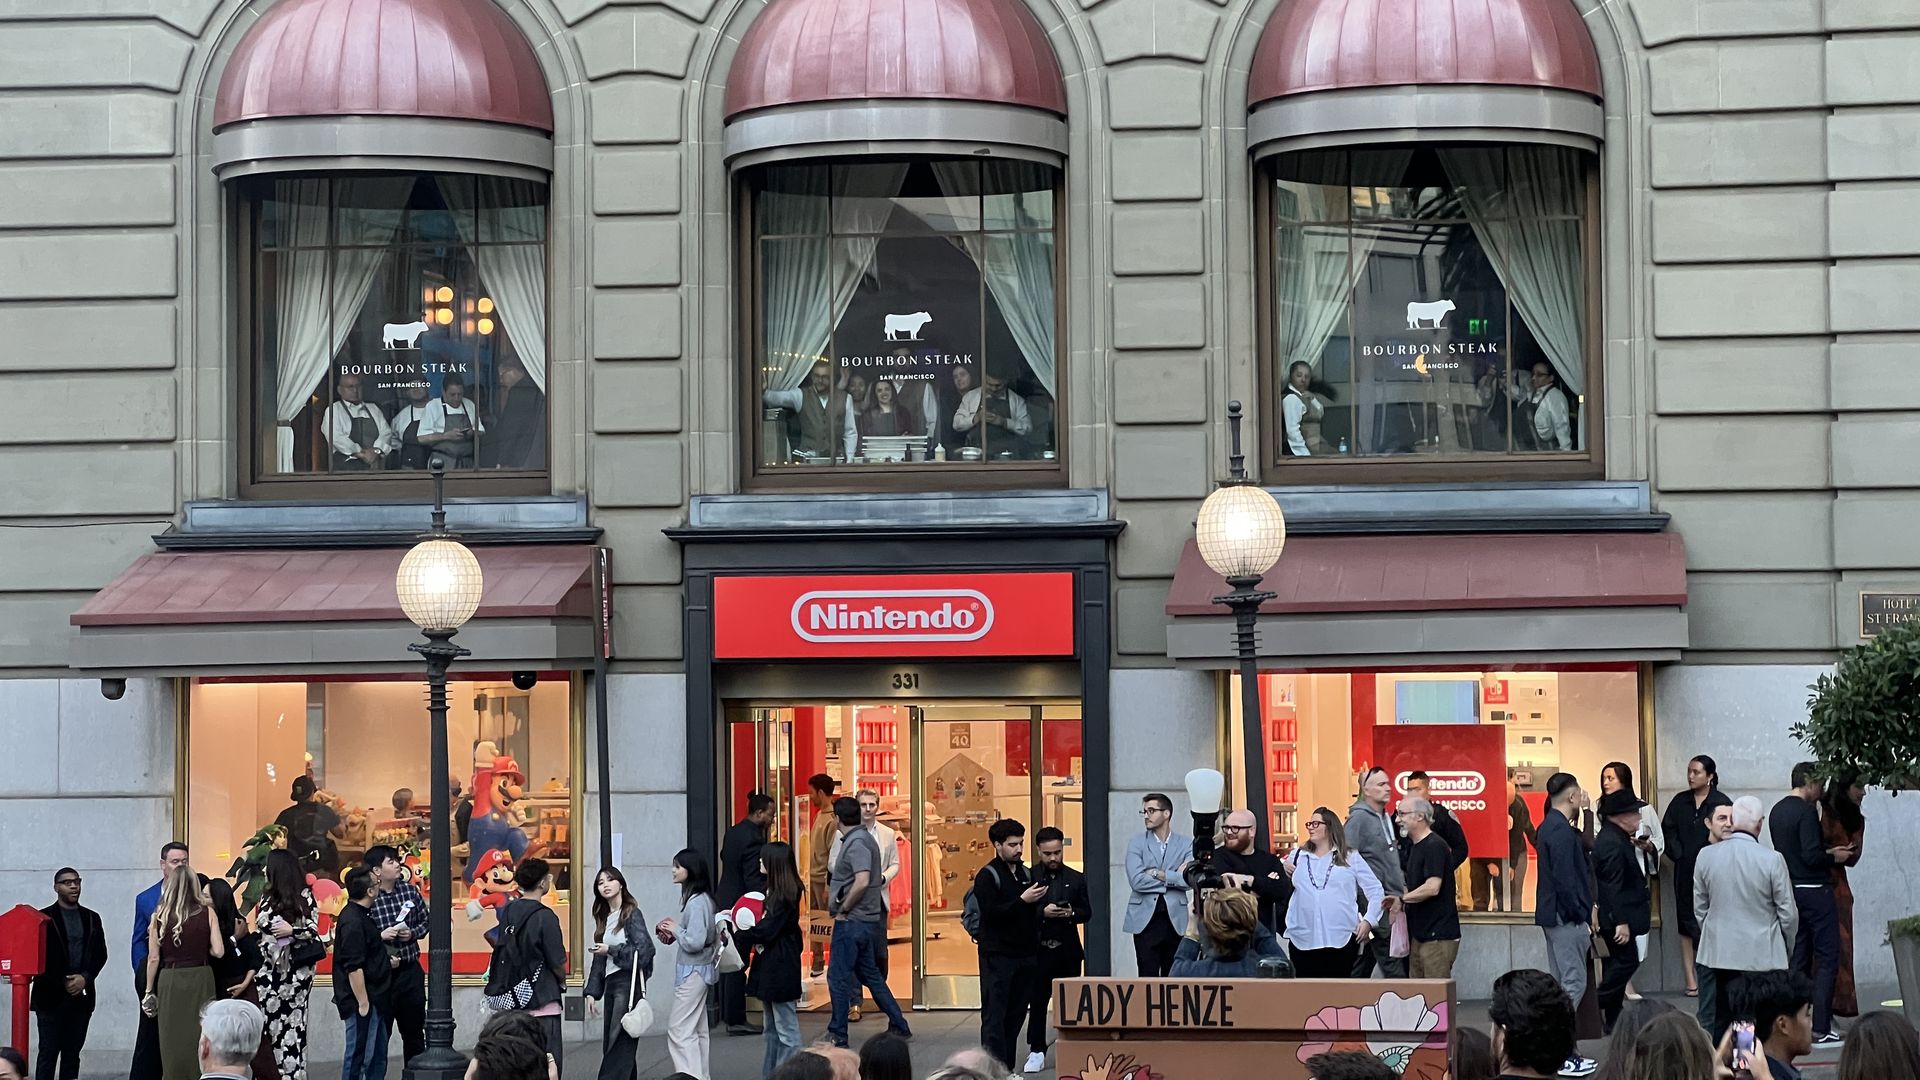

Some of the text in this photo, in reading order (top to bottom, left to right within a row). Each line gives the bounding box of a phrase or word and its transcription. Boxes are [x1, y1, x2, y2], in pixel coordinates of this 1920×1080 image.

[1469, 319, 1488, 335] EXT
[1363, 342, 1497, 356] BOURBON STEAK
[841, 354, 973, 367] BOURBON STEAK
[341, 363, 467, 376] BOURBON STEAK
[895, 373, 935, 381] FRANCISCO
[393, 381, 431, 389] FRANCISCO
[1867, 613, 1880, 624] ST
[892, 673, 919, 690] 331
[951, 735, 969, 747] 40
[1403, 776, 1479, 791] tendo
[1431, 800, 1486, 811] NCISCO
[810, 924, 833, 936] NIKE
[1059, 982, 1234, 1027] LADY HENZE
